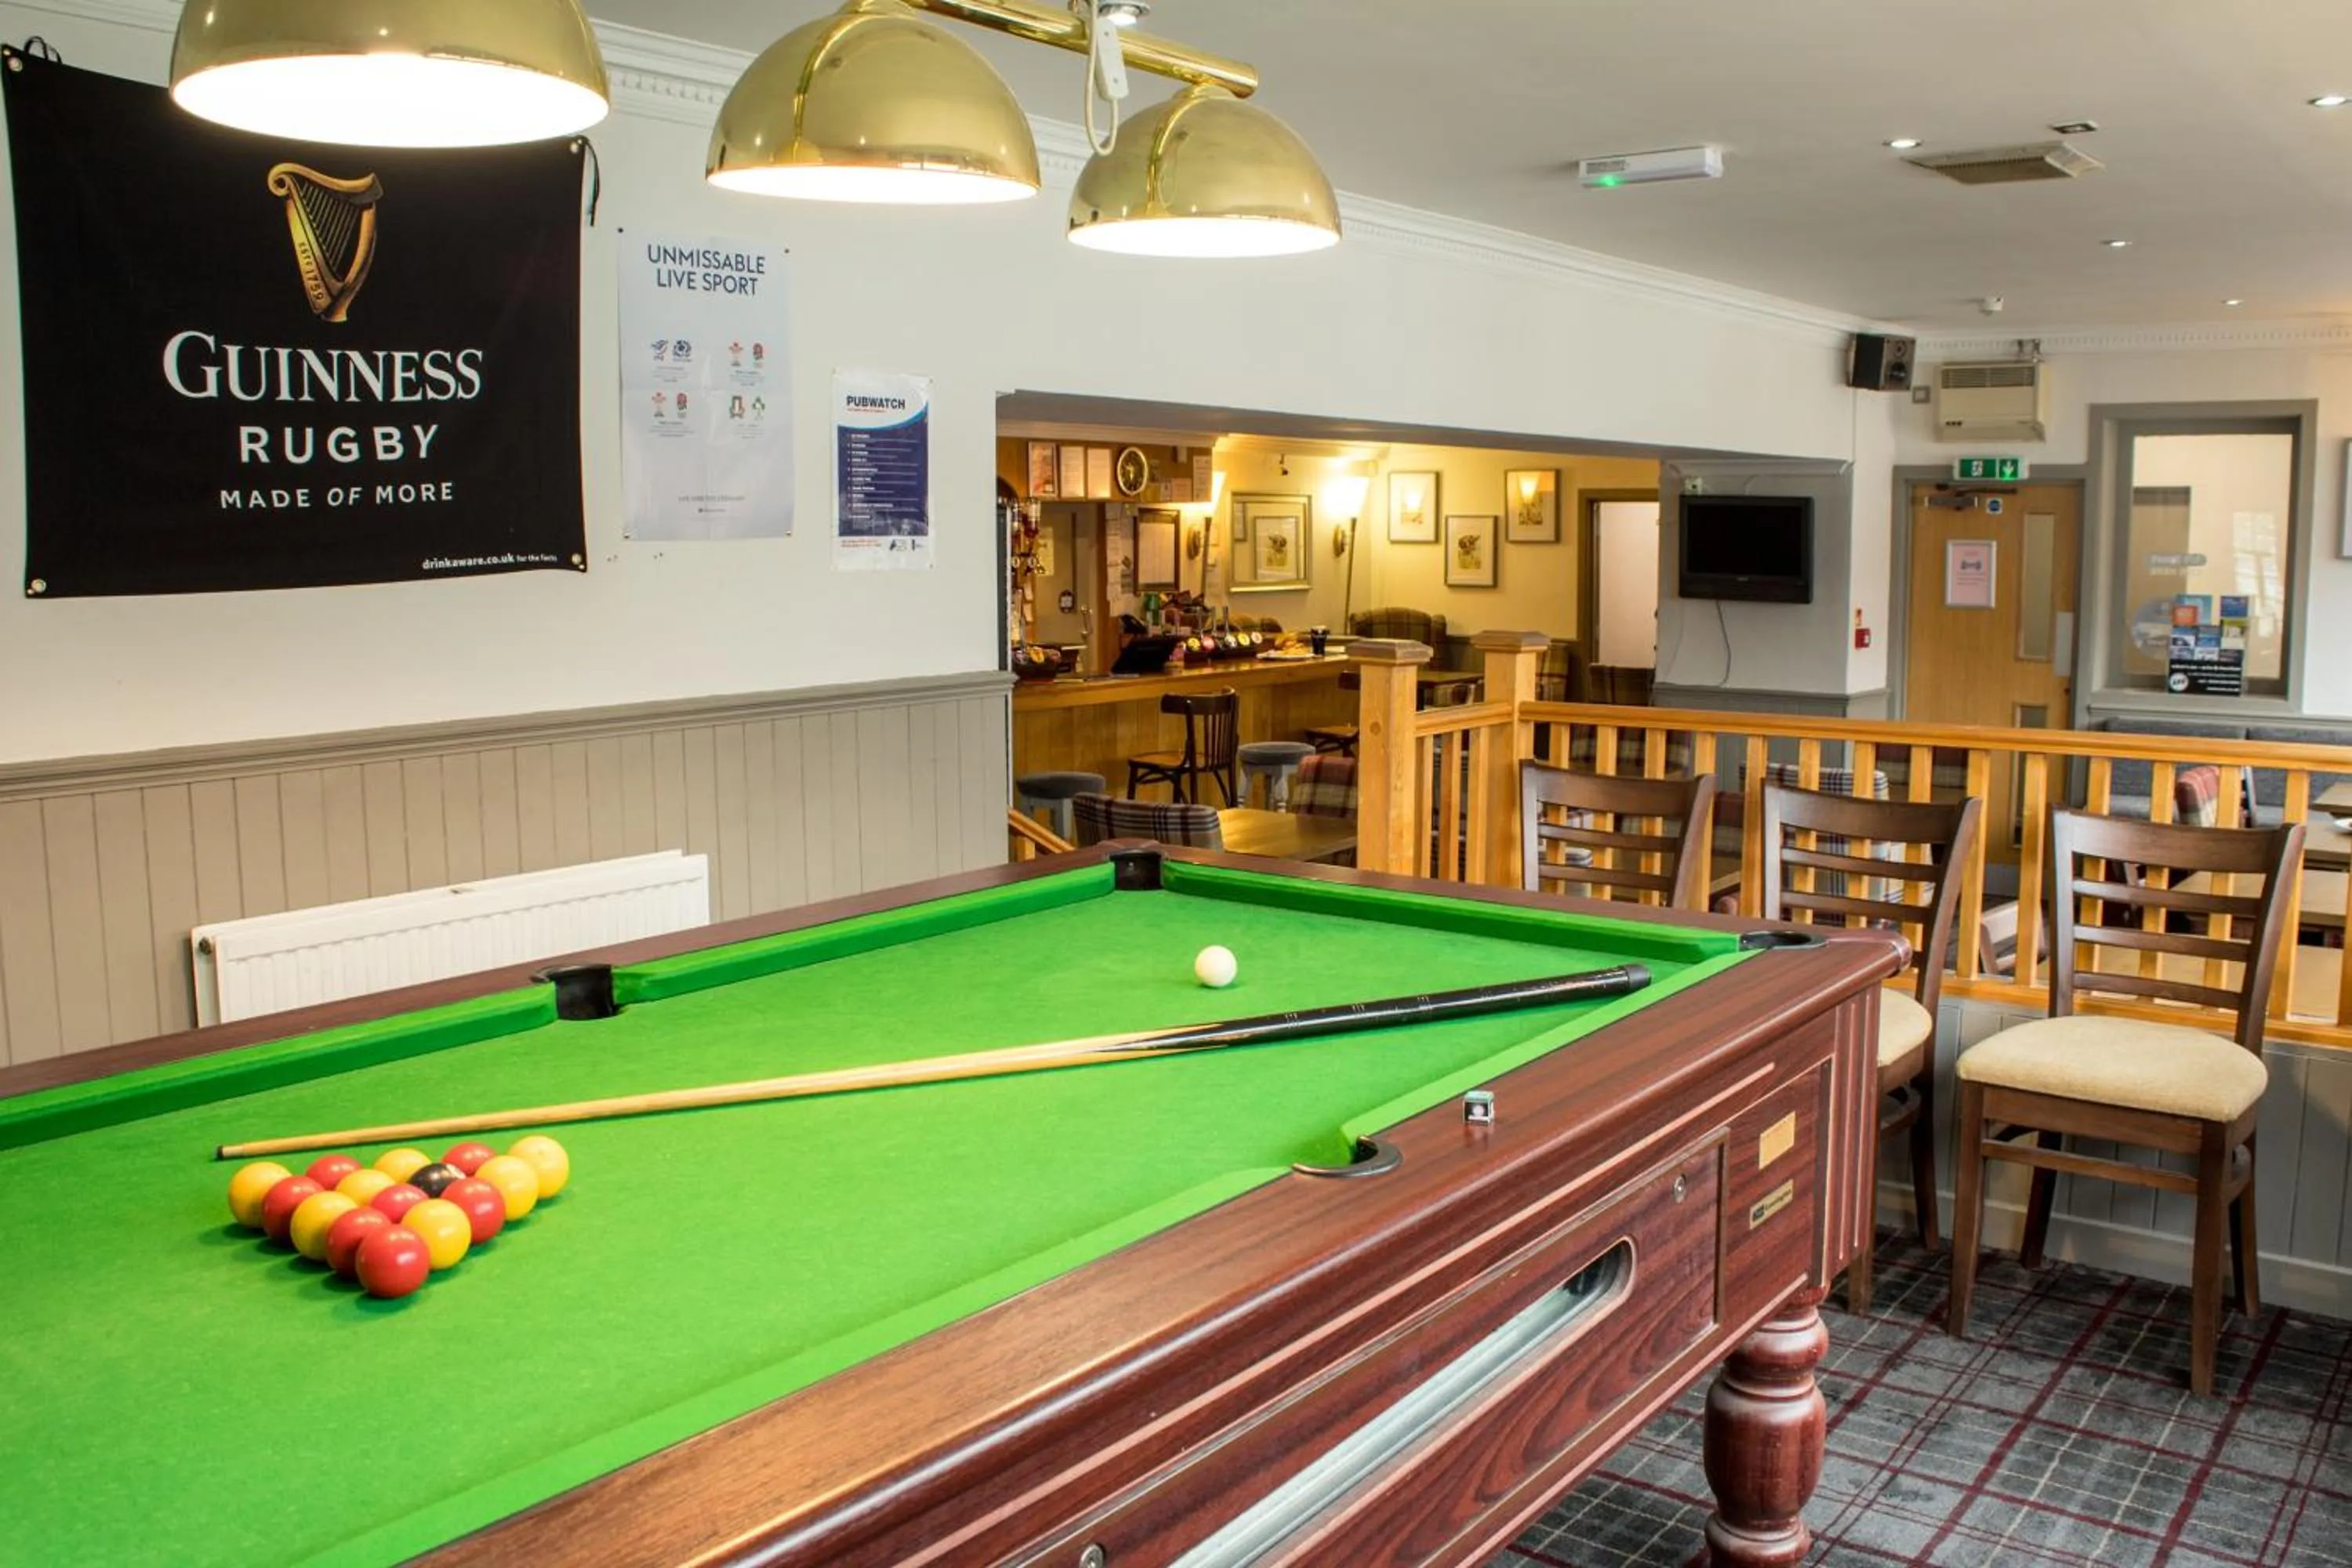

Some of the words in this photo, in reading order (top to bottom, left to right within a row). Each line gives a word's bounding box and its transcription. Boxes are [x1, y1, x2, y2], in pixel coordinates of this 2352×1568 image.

[647, 244, 765, 274] UNMISSABLE
[656, 268, 697, 290] LIVE
[702, 272, 758, 296] SPORT
[163, 330, 484, 402] GUINNESS
[847, 395, 906, 409] PUBWATCH
[240, 424, 438, 464] RUGBY
[220, 488, 310, 509] MADE
[327, 487, 362, 506] OF
[376, 481, 452, 504] MORE
[422, 553, 515, 570] drinkaware.co.uk
